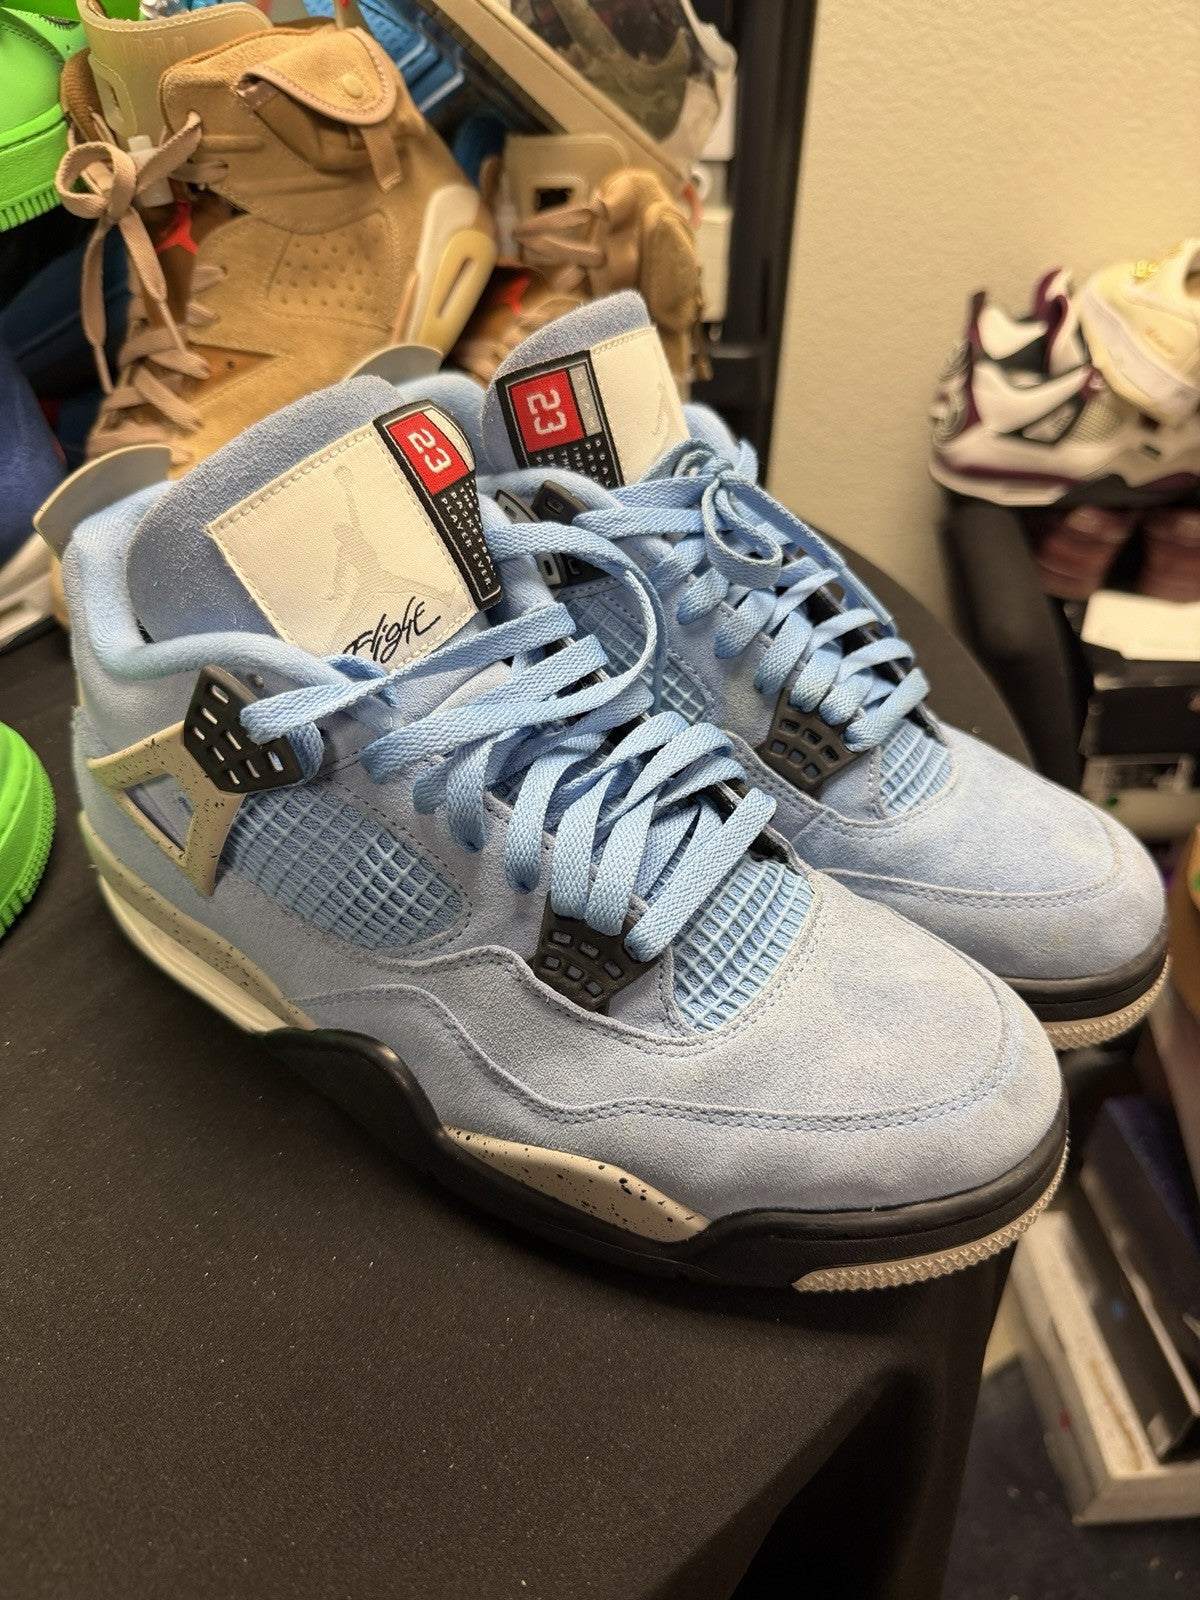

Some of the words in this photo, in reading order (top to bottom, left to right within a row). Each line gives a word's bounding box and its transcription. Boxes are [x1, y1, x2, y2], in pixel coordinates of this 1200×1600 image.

[526, 389, 568, 435] 23
[407, 428, 452, 473] 23
[585, 442, 600, 483] PROD
[595, 440, 612, 487] QUAL
[441, 497, 472, 548] PLAYER
[472, 552, 492, 589] EVER.
[342, 595, 442, 664] Flight
